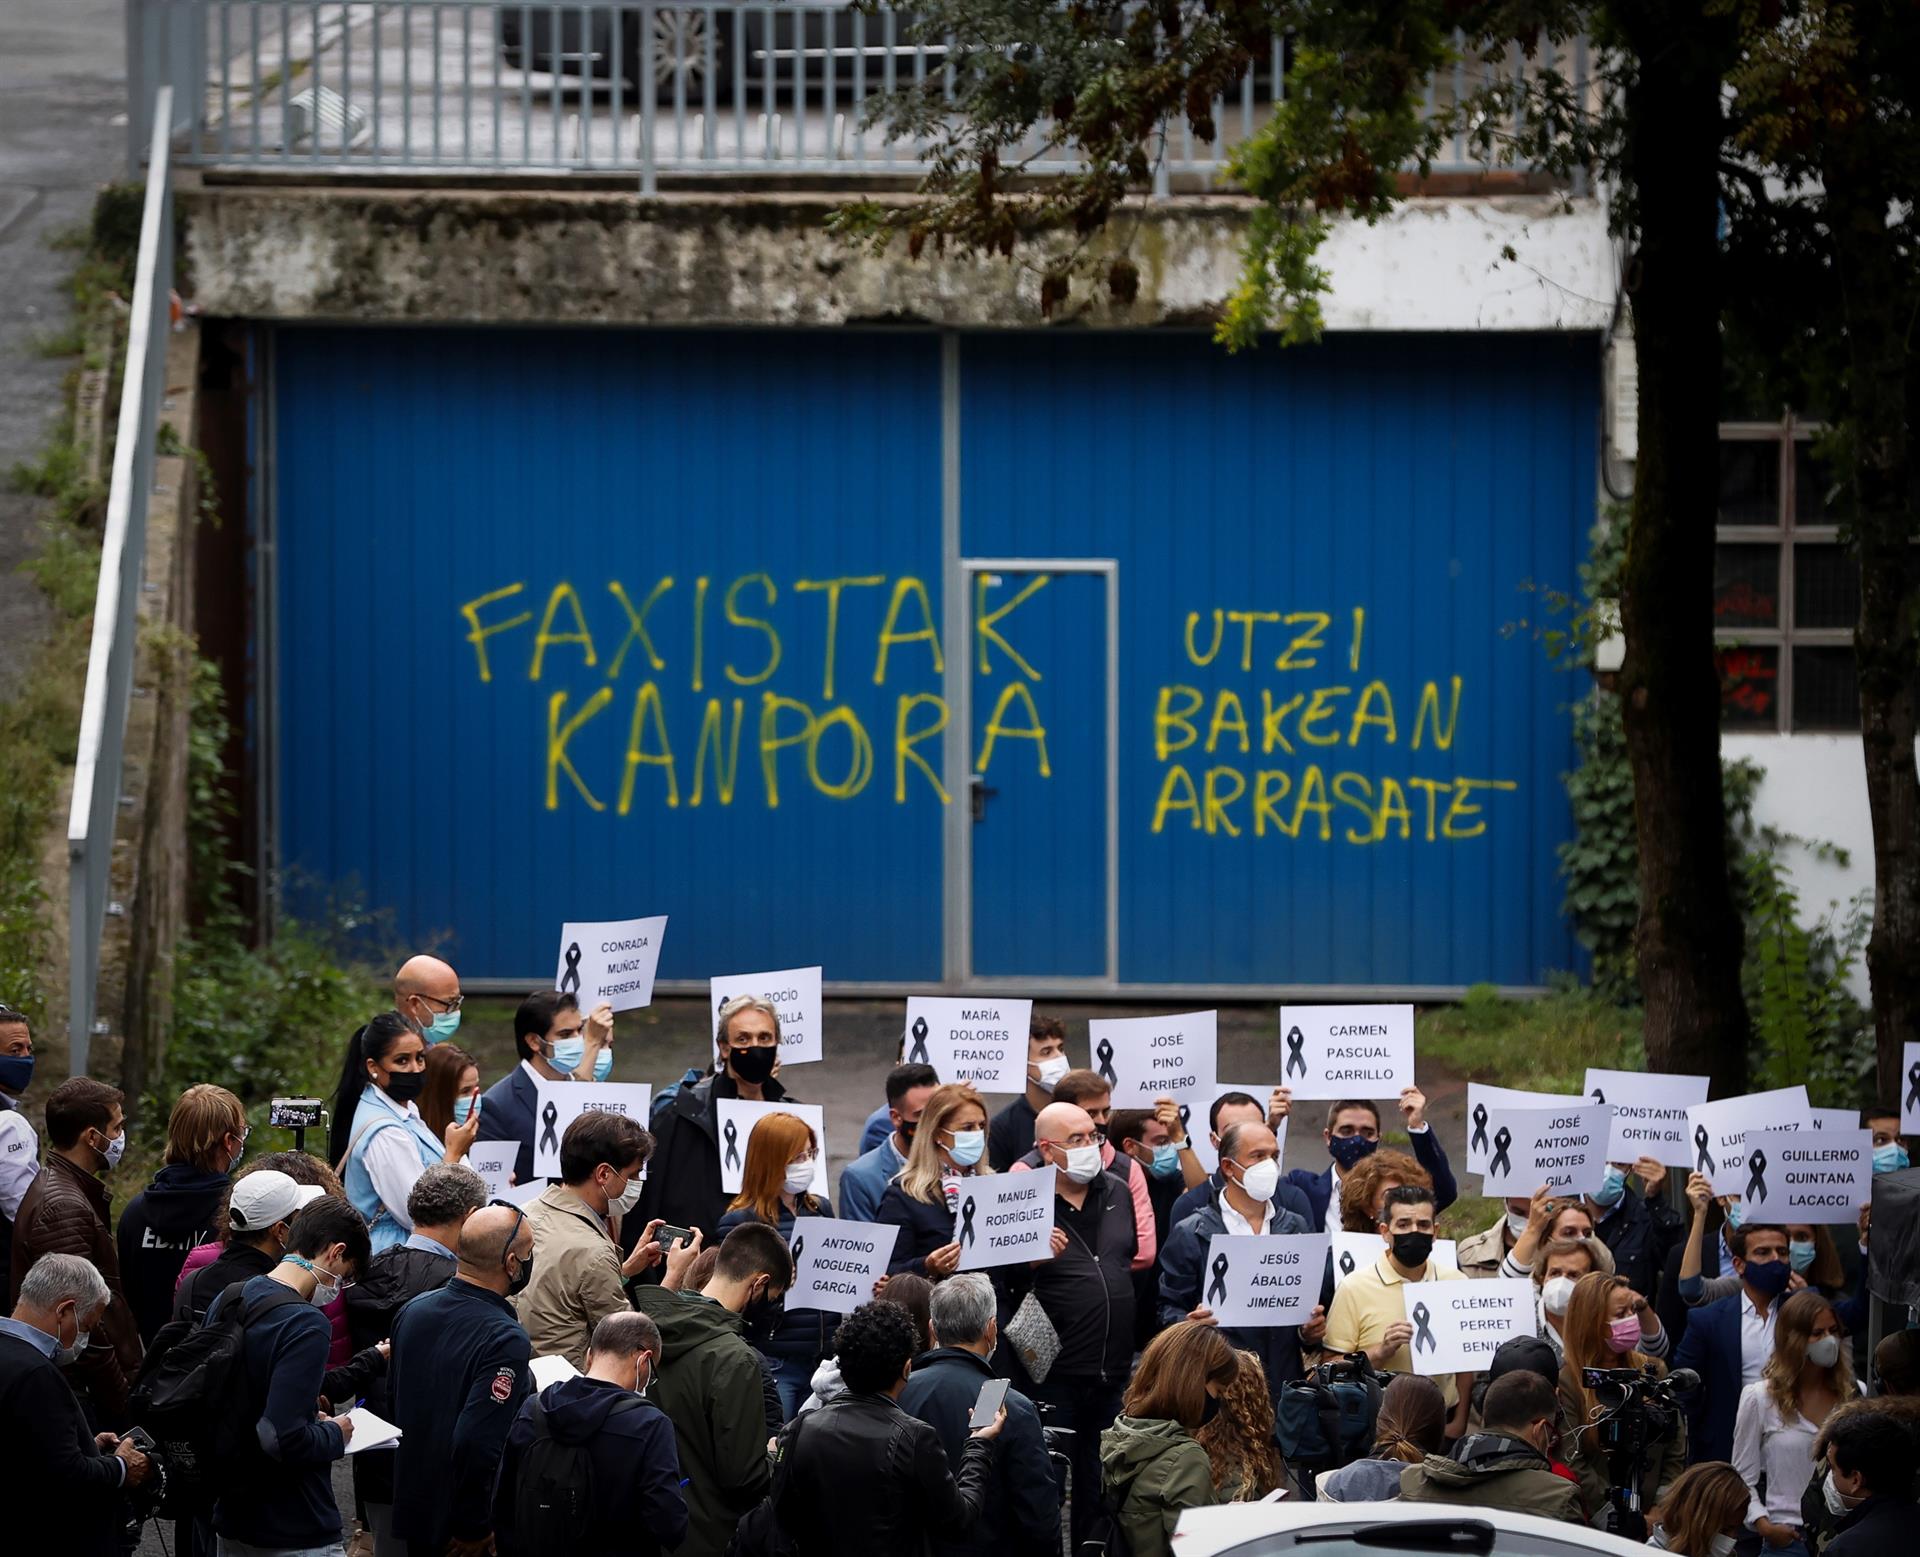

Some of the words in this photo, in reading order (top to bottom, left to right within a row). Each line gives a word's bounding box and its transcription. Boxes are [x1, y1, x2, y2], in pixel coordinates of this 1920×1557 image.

[461, 573, 1049, 699] FAXISTAK
[1185, 606, 1364, 671] UTZI
[1154, 675, 1462, 760] BAKEAN
[545, 682, 1051, 815] KANPORA
[1151, 764, 1517, 843] ARRASATE
[601, 936, 648, 953] CONRADA
[607, 959, 640, 975] MUÑOZ
[598, 980, 641, 997] HERRERA
[777, 1011, 804, 1024] PILLA
[961, 1008, 1001, 1021] MARÍA
[950, 1029, 1009, 1041] DOLORES
[1329, 1024, 1388, 1037] CARMEN
[1150, 1032, 1185, 1048] JOSÉ
[953, 1049, 1004, 1062] FRANCO
[1326, 1046, 1391, 1059] PASCUAL
[1153, 1056, 1184, 1069] PINO
[957, 1067, 1000, 1081] MUÑOZ
[1325, 1068, 1394, 1082] CARRILLO
[1139, 1075, 1196, 1092] ARRIERO
[583, 1102, 627, 1114] ESTHER
[1548, 1114, 1581, 1130] JOSÉ
[1535, 1135, 1590, 1149] ANTONIO
[1622, 1128, 1661, 1141] ORTÍN
[1664, 1131, 1683, 1142] GIL
[1535, 1154, 1586, 1169] MONTES
[1782, 1149, 1860, 1162] GUILLERMO
[478, 1161, 503, 1173] CARMEN
[1545, 1174, 1573, 1188] GILA
[1785, 1171, 1855, 1185] QUINTANA
[997, 1188, 1038, 1204] MANUEL
[1789, 1194, 1850, 1207] LACACCI
[986, 1207, 1045, 1227] RODRÍGUEZ
[821, 1237, 875, 1254] ANTONIO
[989, 1231, 1039, 1249] TABOADA
[1259, 1250, 1300, 1265] JESÚS
[812, 1258, 871, 1275] NOGUERA
[1250, 1271, 1302, 1288] ÁBALOS
[812, 1280, 857, 1296] GARCÍA
[1247, 1293, 1300, 1309] JIMÉNEZ
[1452, 1296, 1514, 1309] CLÉMENT
[1460, 1319, 1512, 1331] PERRET
